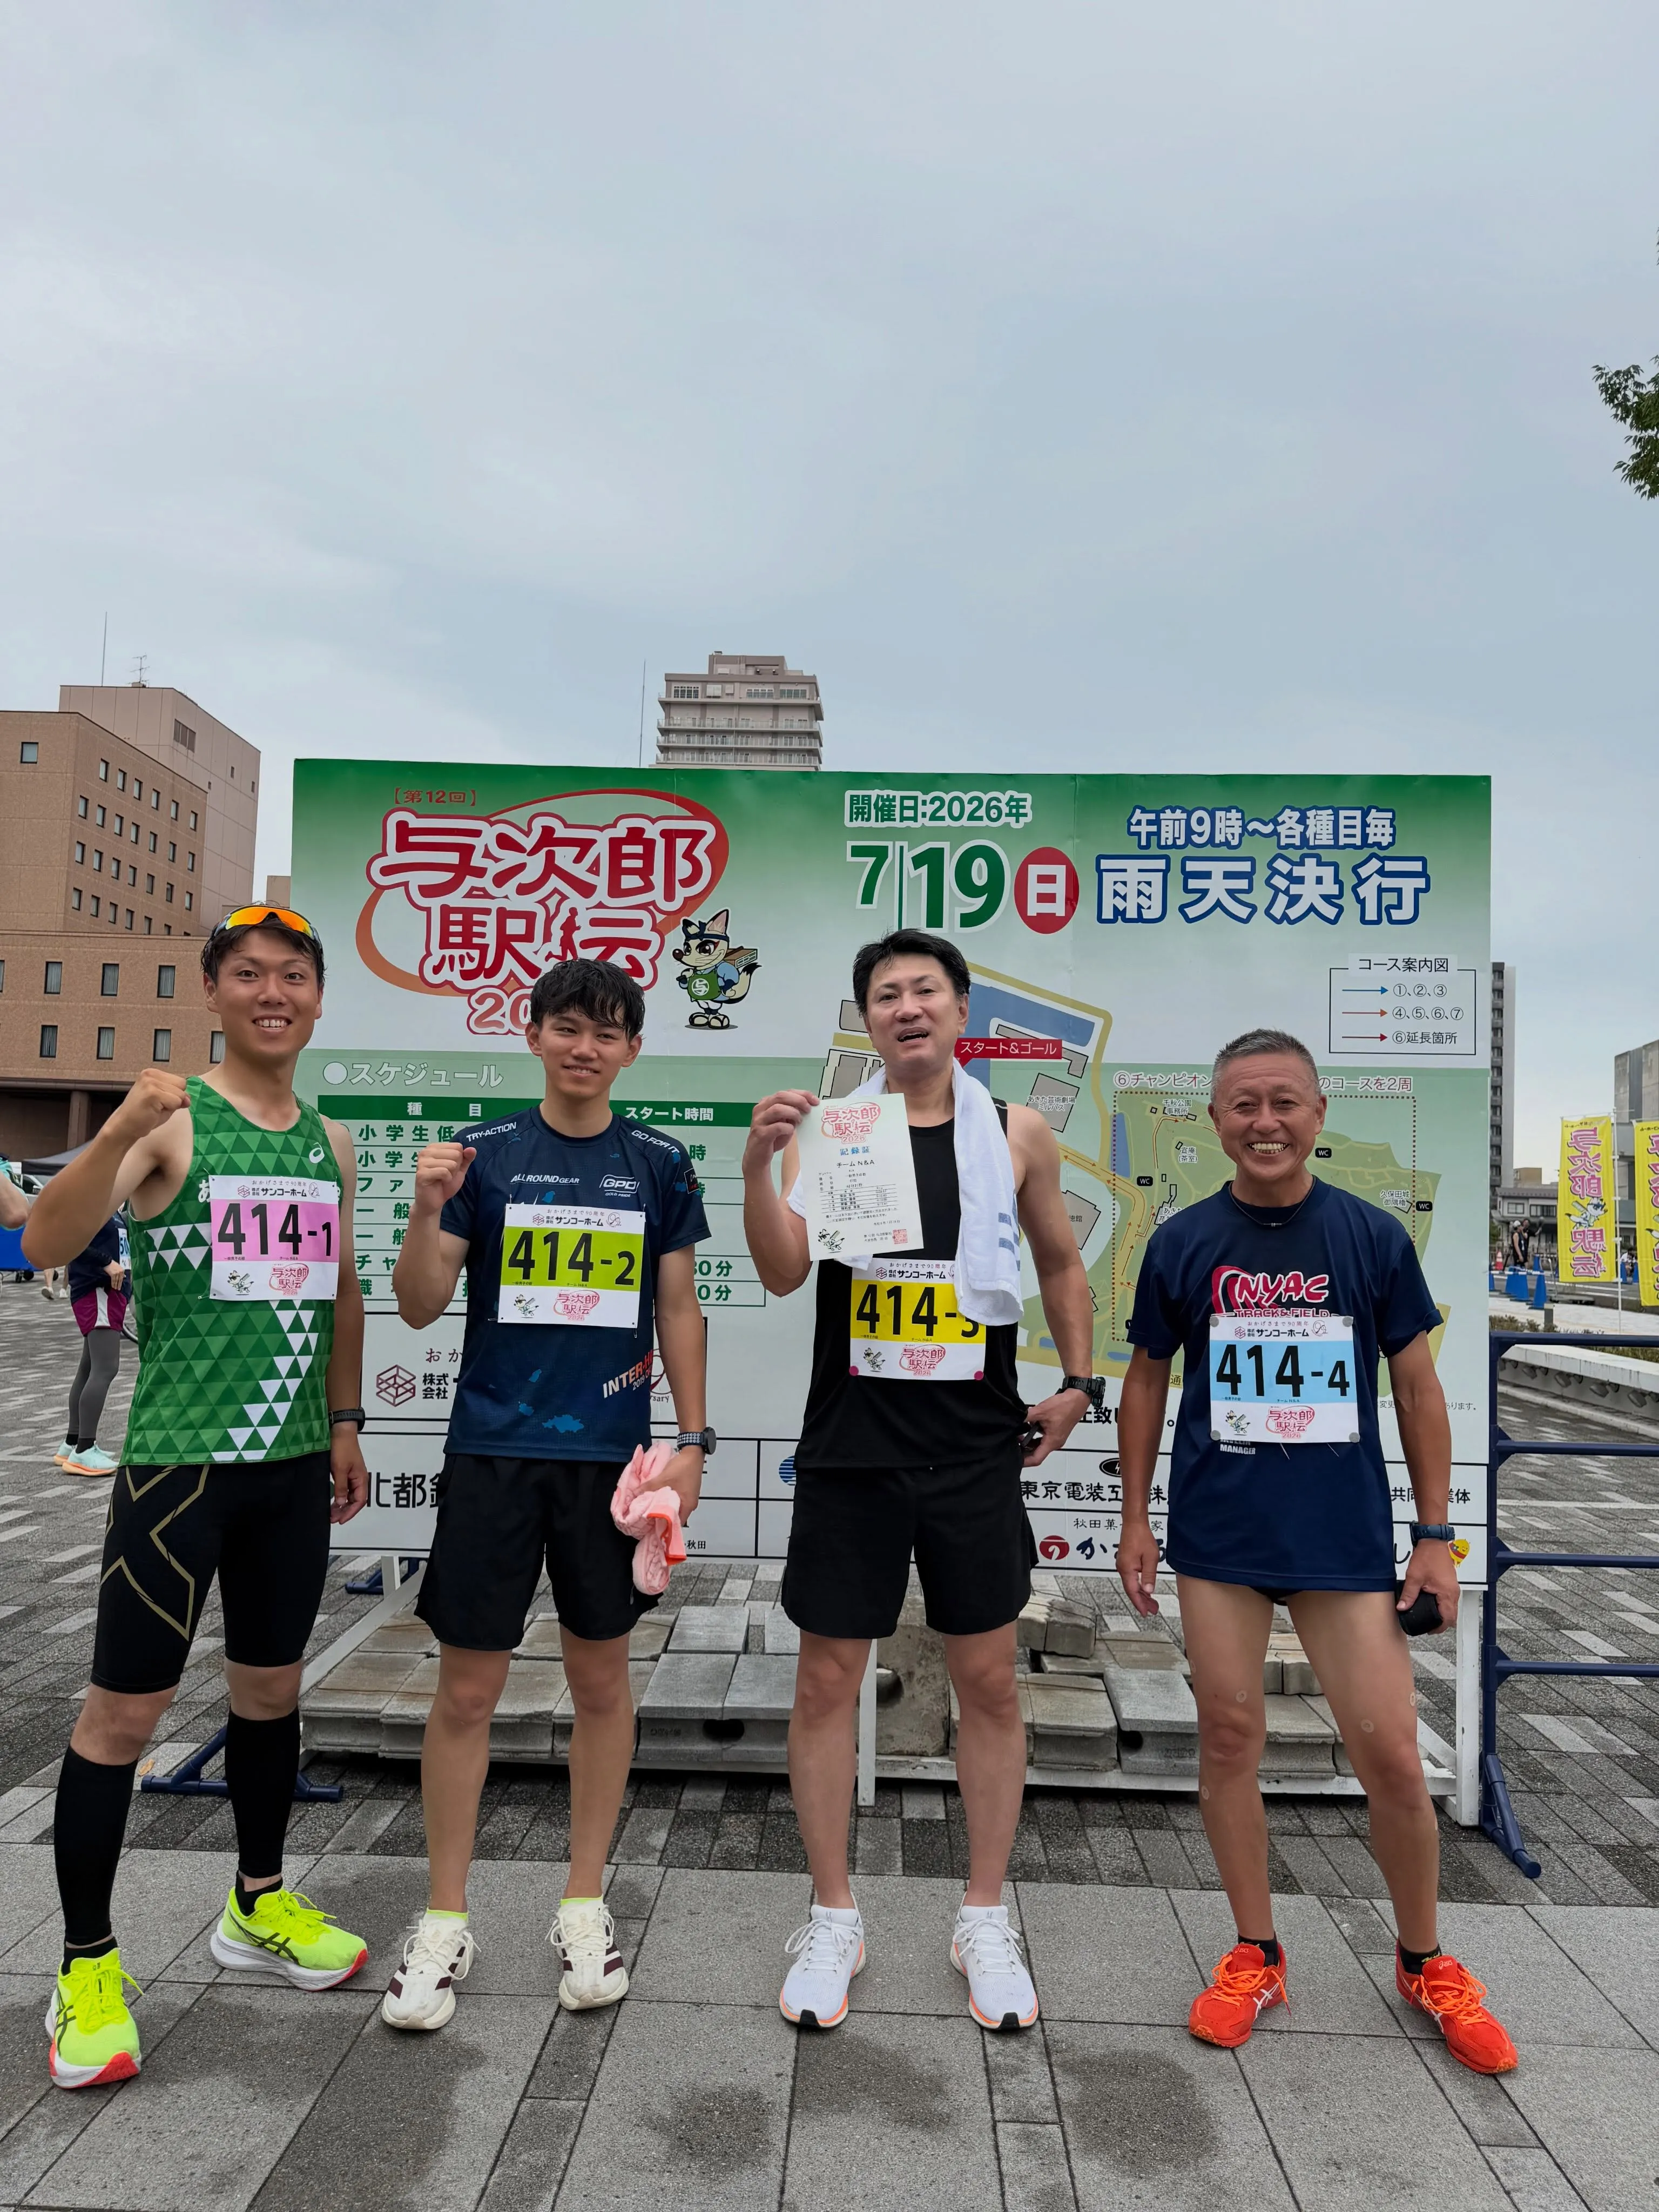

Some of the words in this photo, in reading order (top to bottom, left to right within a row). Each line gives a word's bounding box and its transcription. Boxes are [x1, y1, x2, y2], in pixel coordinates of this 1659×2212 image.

[380, 819, 707, 904] 与次郎
[1100, 857, 1427, 922] 雨天決行
[432, 902, 655, 981] 駅伝
[1358, 957, 1448, 973] コース案内図
[1392, 1030, 1458, 1044] ⑥延長箇所
[961, 1042, 1056, 1055] スタート&ゴール
[1028, 1096, 1075, 1104] あきた芸術劇場
[1163, 1099, 1192, 1107] 千秋公園
[625, 1107, 714, 1122] スタート時間
[824, 1108, 879, 1122] 与次郎
[466, 1122, 517, 1142] TRY-ACTION
[834, 1121, 872, 1136] 駅伝
[631, 1129, 647, 1142] GO
[646, 1136, 671, 1149] FOR
[261, 1188, 307, 1197] サンコーホーム
[555, 1216, 604, 1226] サンコーホーム
[218, 1203, 332, 1257] 414-1
[120, 1237, 130, 1255] 50
[508, 1230, 635, 1286] 414-2
[272, 1267, 308, 1278] 与次郎
[694, 1260, 733, 1277] 0分
[897, 1270, 946, 1279] サンコーホーム
[279, 1278, 302, 1289] 駅伝
[1236, 1271, 1329, 1305] NYAC
[557, 1293, 598, 1304] 与次郎
[563, 1304, 590, 1314] 駅伝
[1256, 1328, 1310, 1337] サンコーホーム
[902, 1348, 944, 1359] 与次郎
[909, 1359, 936, 1370] 駅伝
[1216, 1344, 1350, 1397] 414-4
[1268, 1410, 1312, 1421] 与次郎
[1276, 1421, 1306, 1432] 駅伝
[1219, 1444, 1256, 1455] MANAGER
